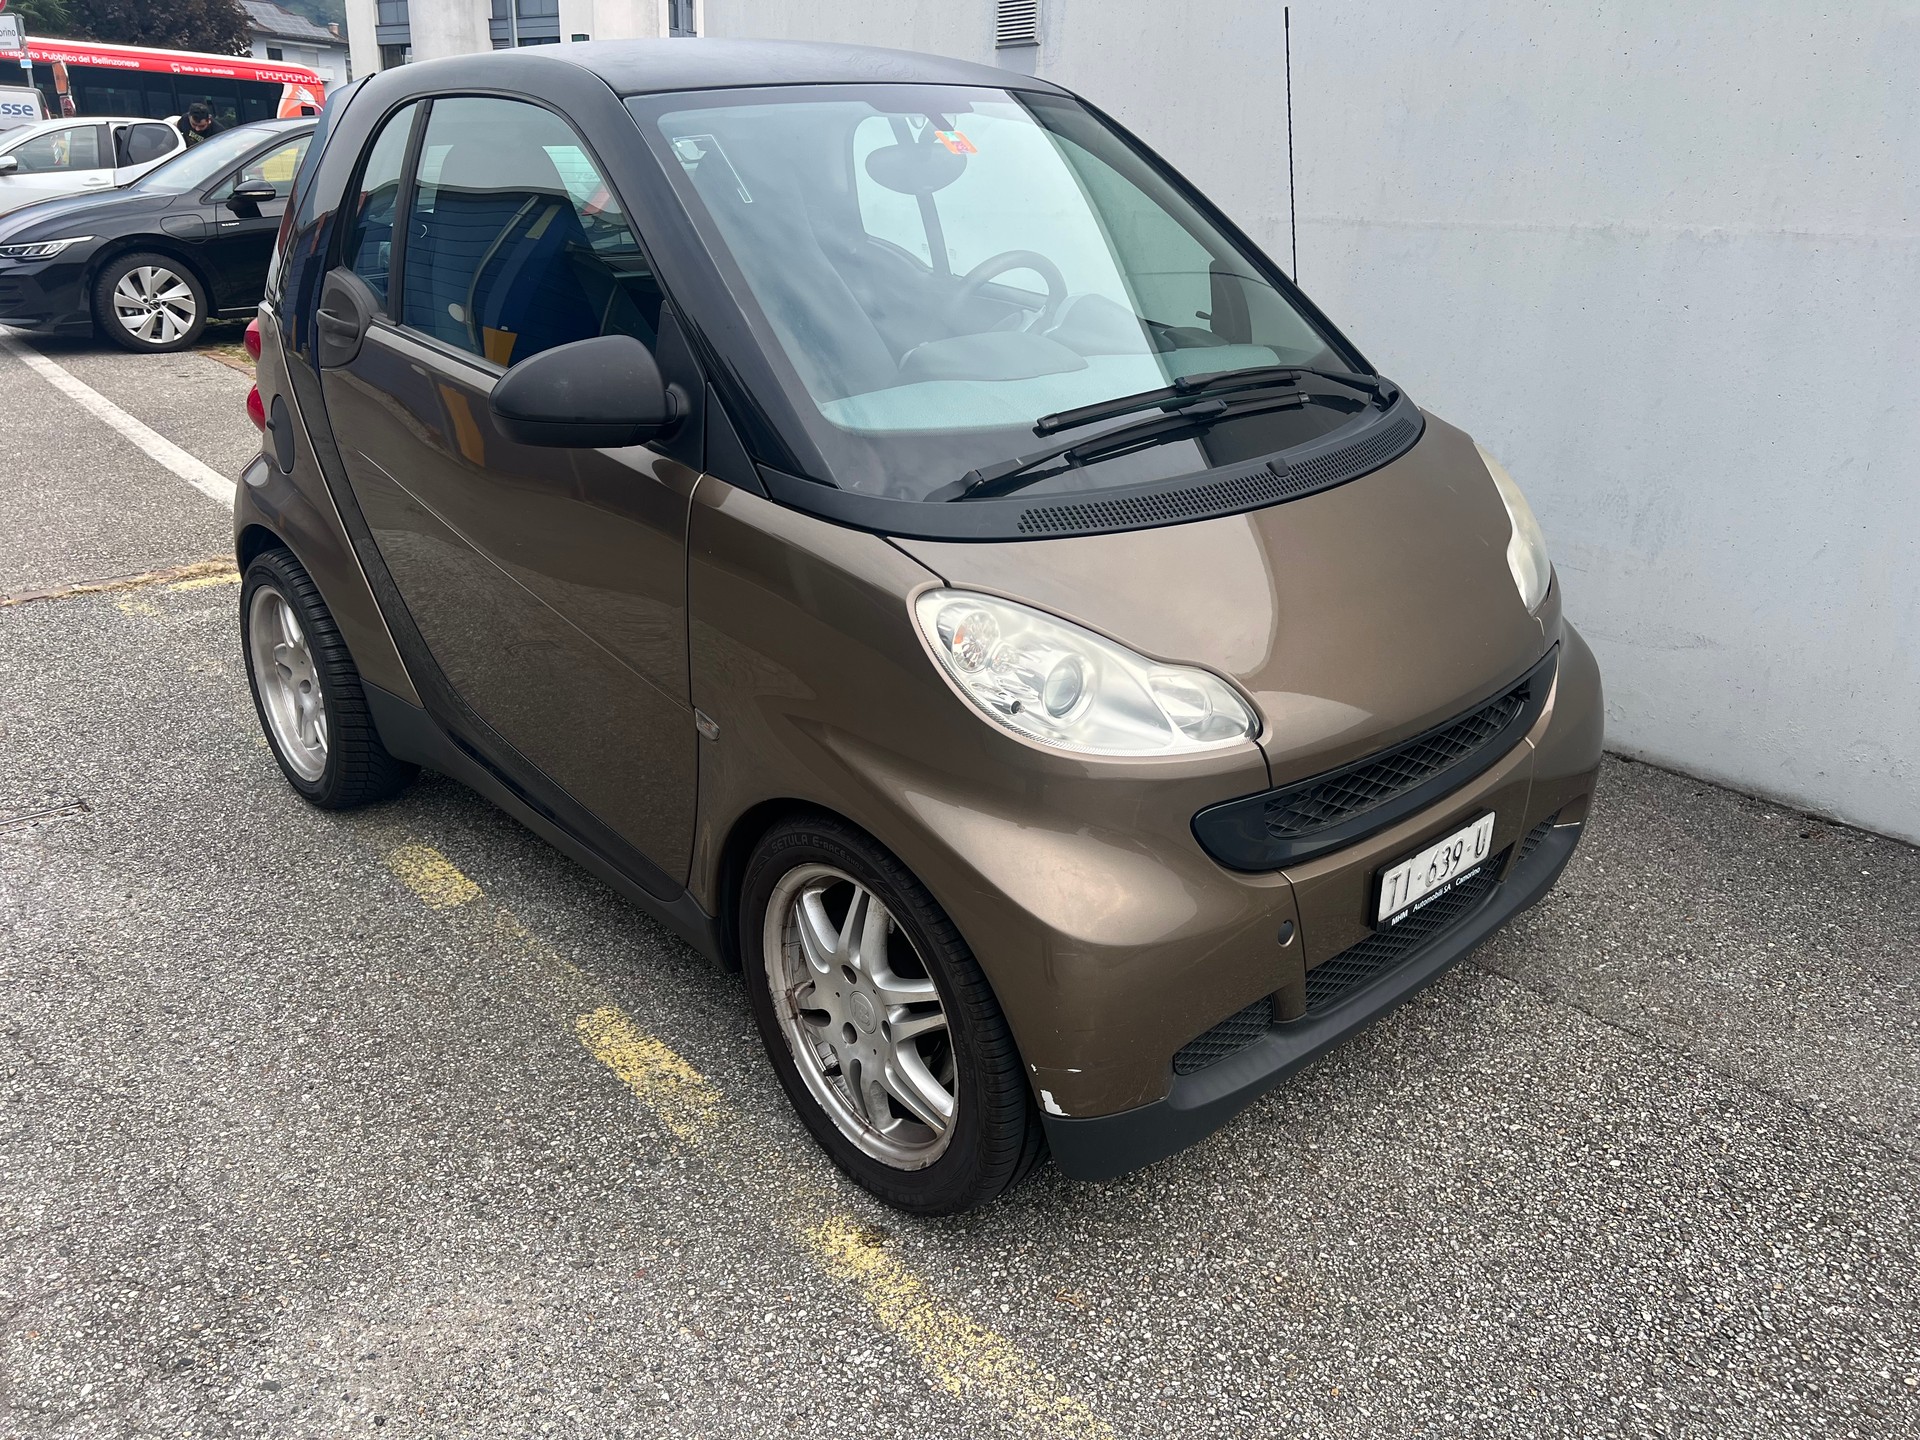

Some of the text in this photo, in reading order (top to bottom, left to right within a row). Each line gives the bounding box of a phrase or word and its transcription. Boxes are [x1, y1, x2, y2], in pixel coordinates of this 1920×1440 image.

[78, 55, 90, 63] del
[0, 103, 34, 116] sse
[771, 834, 809, 853] SETULA
[1412, 887, 1443, 913] Automobili
[1442, 883, 1452, 894] SA
[1455, 866, 1481, 886] Camorino
